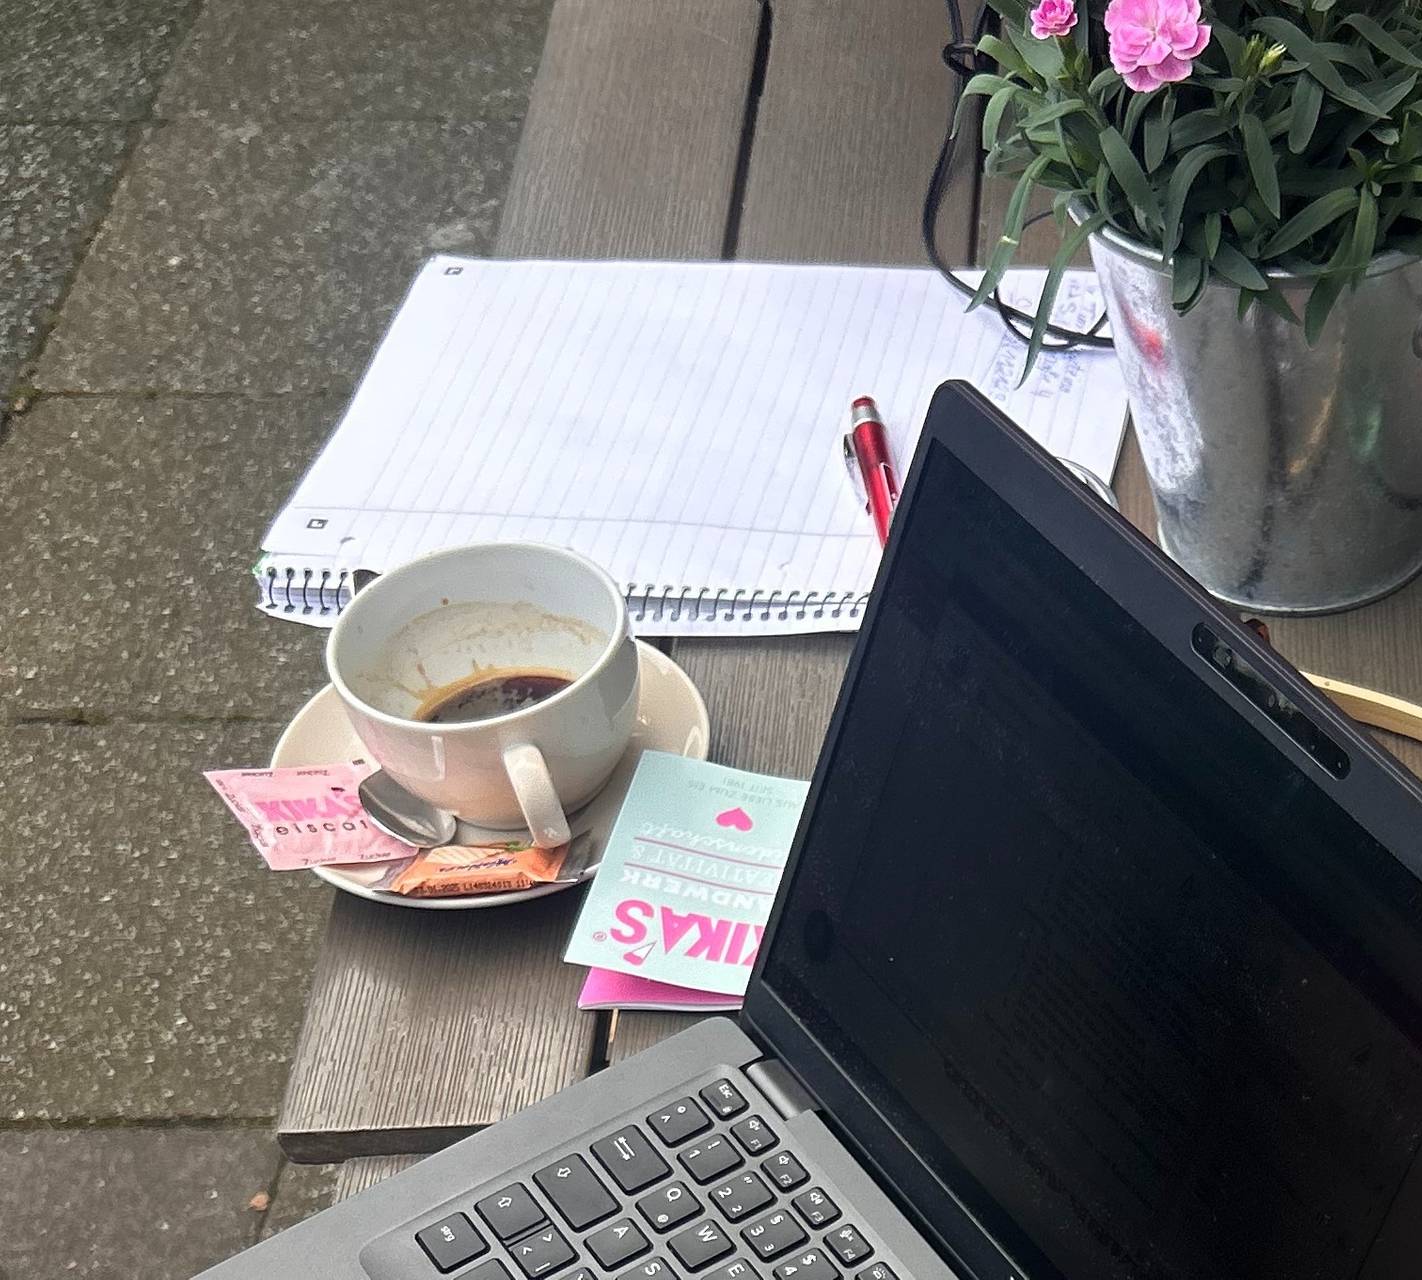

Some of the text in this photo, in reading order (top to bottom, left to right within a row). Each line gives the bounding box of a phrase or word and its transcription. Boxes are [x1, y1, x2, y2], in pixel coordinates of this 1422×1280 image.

[666, 1187, 682, 1202] Q
[717, 1187, 732, 1199] 2
[613, 1226, 629, 1239] A
[698, 1225, 718, 1243] W
[750, 1225, 765, 1237] 3
[645, 1262, 662, 1276] S
[728, 1263, 746, 1278] E
